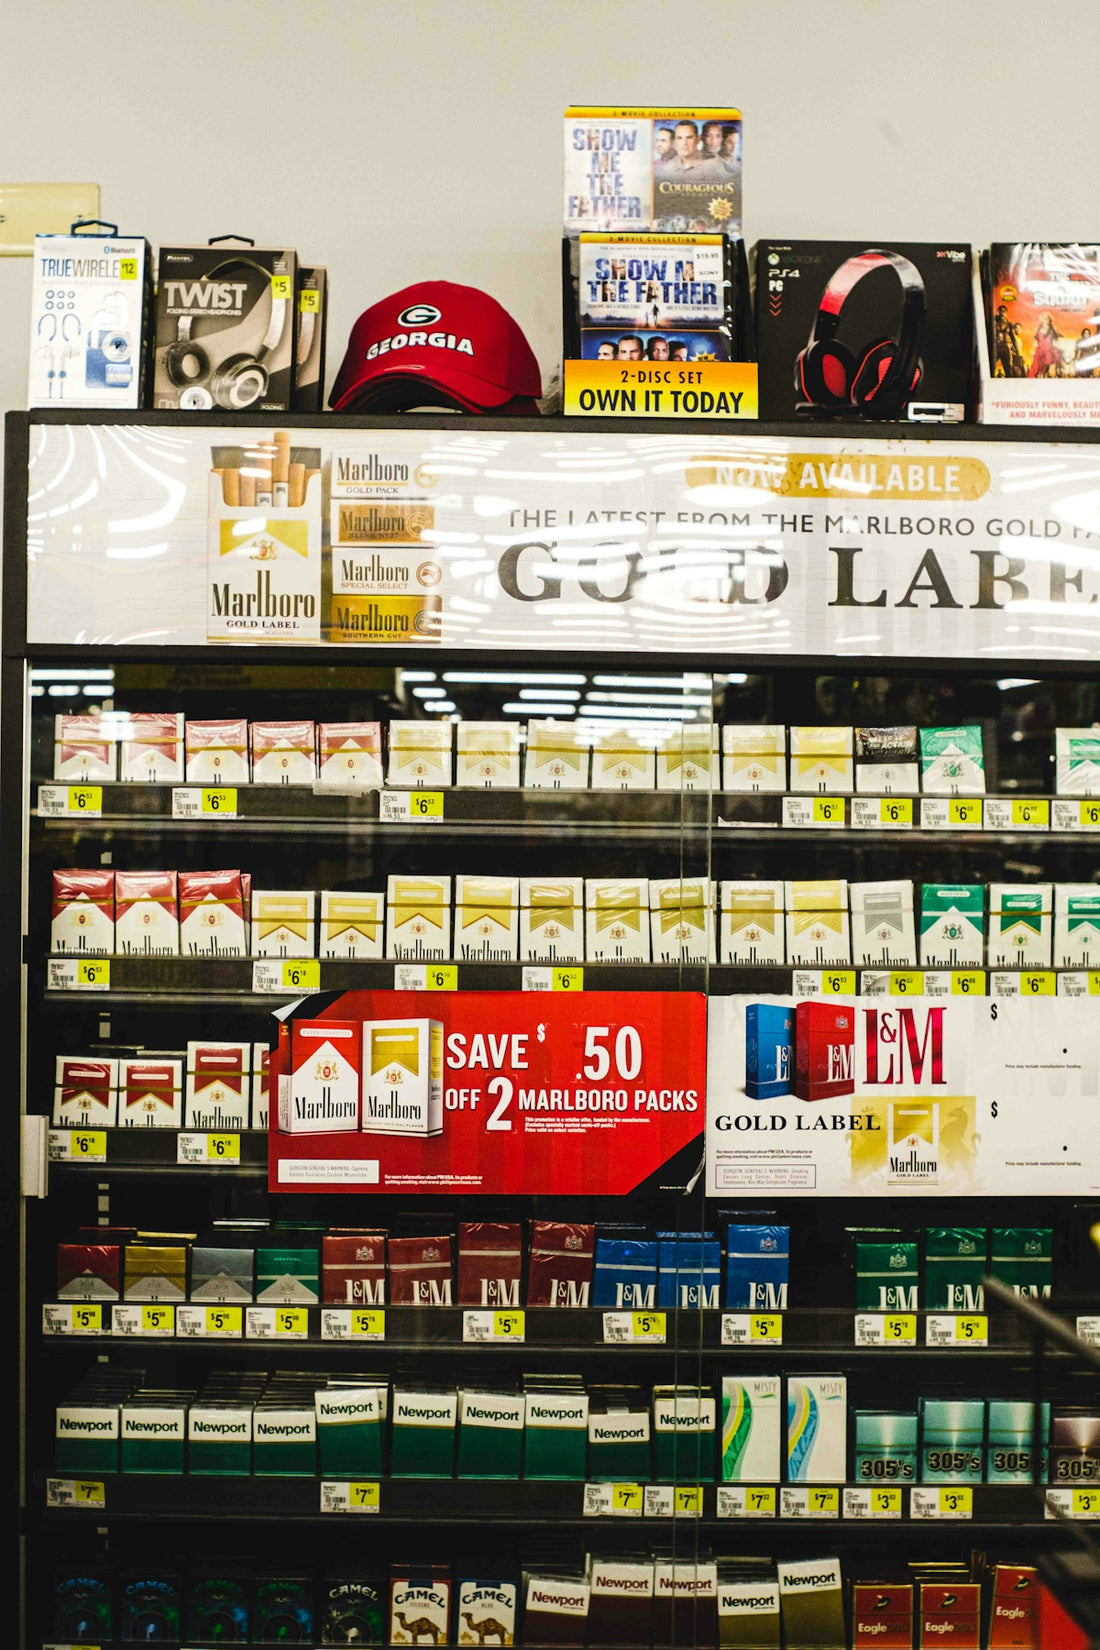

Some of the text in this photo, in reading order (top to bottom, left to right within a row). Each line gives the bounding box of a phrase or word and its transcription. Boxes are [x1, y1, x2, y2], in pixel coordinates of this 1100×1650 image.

[573, 128, 637, 151] SHOW
[591, 151, 620, 173] ME
[586, 173, 624, 195] THE
[659, 181, 734, 195] COURAGEOUS
[568, 195, 641, 218] FATHER
[121, 263, 134, 274] $12
[595, 258, 668, 281] SHOW
[768, 269, 800, 278] PS4
[163, 282, 248, 309] TWIST
[275, 281, 287, 292] $5
[586, 281, 717, 305] THE FATHER
[768, 280, 784, 292] PC
[304, 295, 315, 306] $5
[365, 332, 474, 360] GEORGIA
[620, 370, 703, 384] 2-DISC SET
[579, 389, 744, 414] OWN IT TODAY
[1042, 401, 1071, 410] FUNNY,
[1009, 411, 1086, 419] AND MARVELOUSLY
[337, 454, 409, 481] Marlboro
[799, 462, 960, 492] AVAILABLE
[342, 509, 405, 532] Marlboro
[509, 509, 556, 528] THE
[762, 513, 814, 534] THE
[825, 515, 974, 536] MRLBORO
[986, 519, 1061, 538] GOLD
[340, 554, 409, 582] Marlboro
[497, 541, 789, 604] GOD
[211, 570, 315, 618] Marlboro
[226, 620, 299, 629] GOLD LABEL
[336, 604, 409, 632] Marlboro
[990, 1003, 998, 1020] $
[446, 1023, 642, 1081] SAVE $ .50
[862, 1007, 947, 1084] L&M
[827, 1044, 855, 1081] L&M
[295, 1087, 356, 1120] Marlboro
[368, 1091, 421, 1120] Marlboro
[445, 1076, 698, 1131] OFF 2 MARLBORO PACKS
[990, 1101, 998, 1118] $
[715, 1115, 880, 1131] GOLD LABEL
[890, 1151, 937, 1172] Marlboro
[345, 1279, 385, 1304] L&M
[412, 1279, 452, 1304] L&M
[480, 1278, 521, 1307] L&M
[550, 1278, 591, 1307] L&M
[615, 1282, 656, 1308] L&M
[680, 1284, 720, 1309] L&M
[749, 1282, 788, 1309] L&M
[878, 1286, 918, 1311] L&M
[946, 1284, 985, 1311] L&M
[754, 1382, 777, 1393] MISTY
[819, 1383, 842, 1394] MISTY
[320, 1402, 374, 1415] Newport
[398, 1405, 451, 1419] Newport
[466, 1406, 519, 1421] Newport
[530, 1406, 584, 1419] Newport
[60, 1418, 113, 1431] Newport
[125, 1420, 179, 1433] Newport
[193, 1421, 246, 1434] Newport
[257, 1423, 311, 1437] Newport
[660, 1414, 710, 1427] Newport
[594, 1428, 645, 1440] Newport
[861, 1459, 913, 1479] 305's
[928, 1452, 982, 1472] 305's
[1058, 1459, 1100, 1479] 305'
[596, 1576, 649, 1589] Newport
[659, 1577, 712, 1591] Newport
[783, 1572, 836, 1586] Newport
[329, 1584, 378, 1601] CAMEL
[394, 1590, 446, 1609] CAMEL
[461, 1590, 513, 1609] CAMEL
[532, 1591, 585, 1607] Newport
[722, 1595, 775, 1609] Newport
[996, 1606, 1025, 1618] Eagle
[858, 1623, 887, 1634] Eagle
[925, 1622, 954, 1634] Eagle
